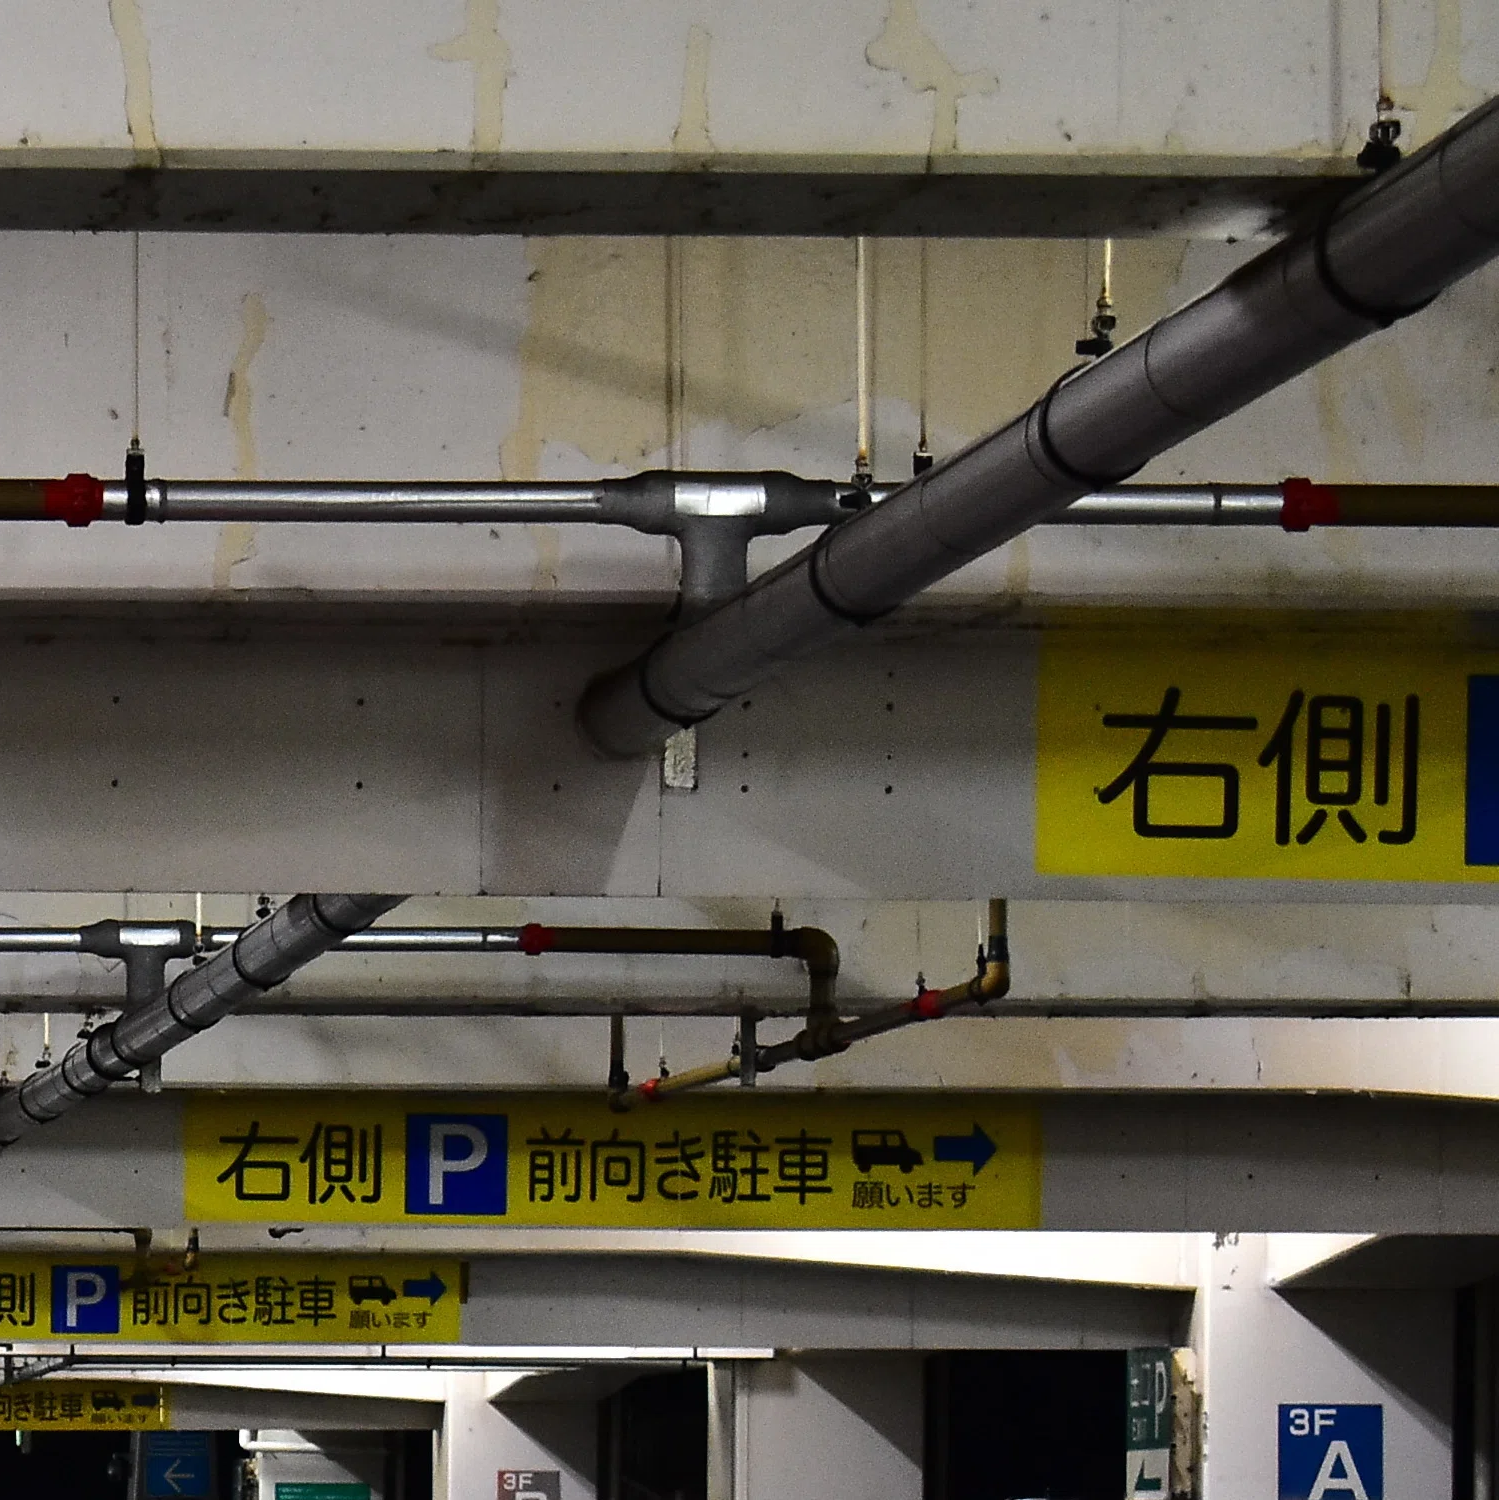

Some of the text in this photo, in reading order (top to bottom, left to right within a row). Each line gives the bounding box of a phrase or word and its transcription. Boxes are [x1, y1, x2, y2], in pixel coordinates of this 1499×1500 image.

[1097, 686, 1420, 846] 右側
[217, 1120, 834, 1206] 右側 P 前向き駐車
[851, 1180, 976, 1211] 願います
[65, 1271, 109, 1328] P
[131, 1274, 338, 1329] 前向き駐車
[348, 1309, 432, 1332] 願います
[1289, 1408, 1338, 1436] 3F
[503, 1473, 533, 1490] 3F
[1308, 1440, 1369, 1500] A
